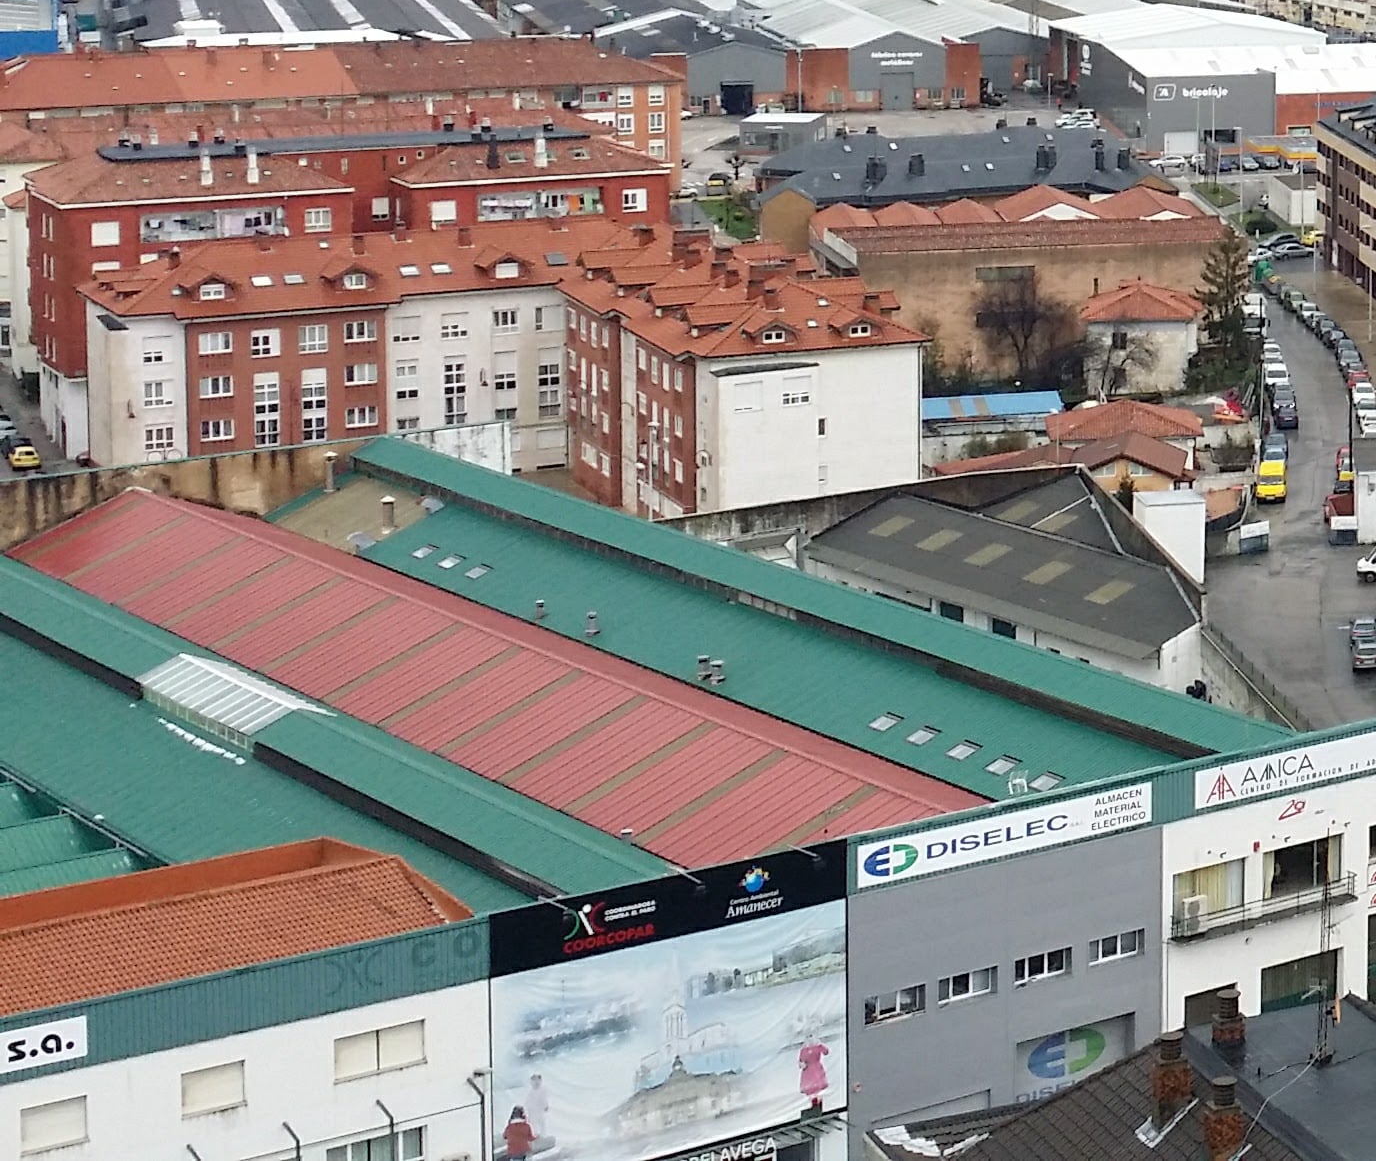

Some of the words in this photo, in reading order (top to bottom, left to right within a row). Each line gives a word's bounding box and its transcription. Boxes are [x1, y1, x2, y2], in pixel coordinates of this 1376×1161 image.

[1182, 86, 1229, 99] bricolaje
[1240, 783, 1271, 796] CENTRO
[1296, 766, 1343, 784] FORMACION
[1241, 754, 1314, 786] AMICA
[1095, 788, 1143, 806] ALMACEN
[1094, 800, 1143, 818] MATERIAL
[1091, 811, 1146, 831] ELECTRICO
[926, 814, 1069, 860] DISELEC
[724, 896, 784, 919] Amanecer
[729, 896, 750, 906] Centro
[563, 922, 655, 954] COORCOPAR
[7, 1033, 75, 1063] s.a.
